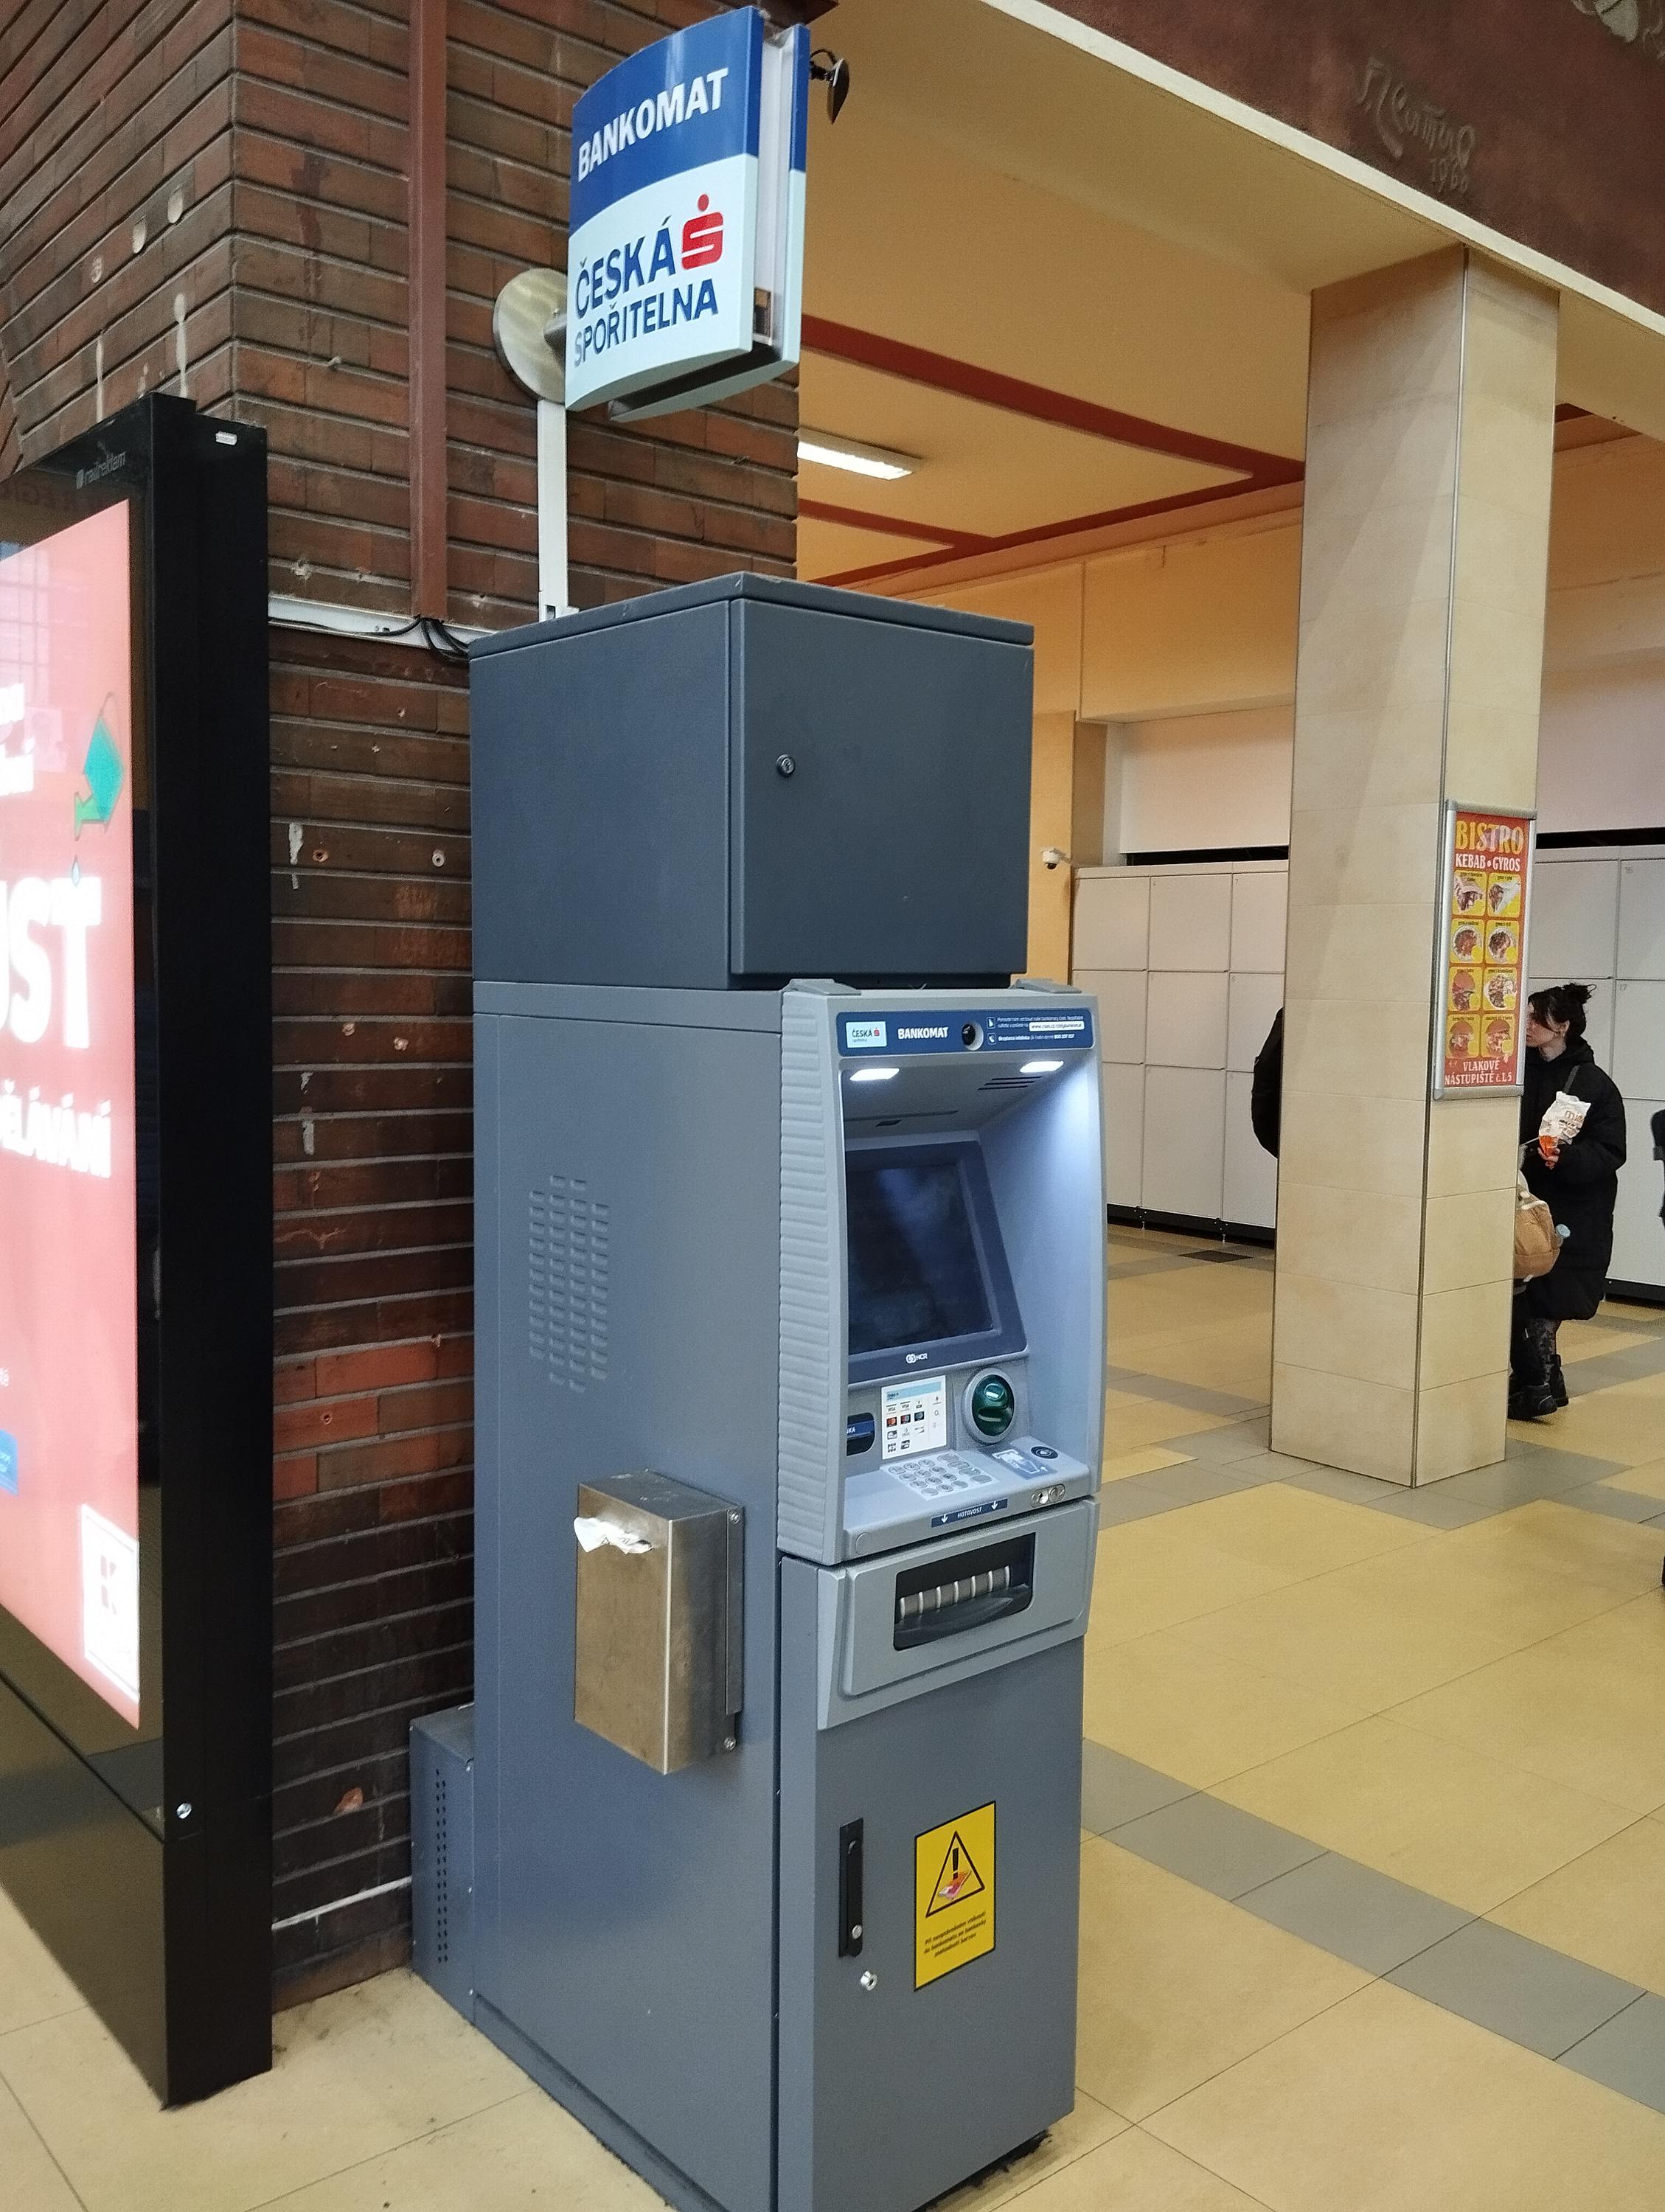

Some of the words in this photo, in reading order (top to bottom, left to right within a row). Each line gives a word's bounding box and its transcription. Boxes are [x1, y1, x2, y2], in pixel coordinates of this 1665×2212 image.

[578, 68, 729, 182] BANKOMAT
[575, 215, 676, 319] ČESKÁ
[573, 278, 719, 367] SPOŘITELNA
[1456, 820, 1524, 855] BISTRO
[1456, 853, 1487, 869] KEBAB
[1492, 856, 1521, 872] GYROS
[852, 1029, 872, 1038] ČESKÁ
[897, 1027, 948, 1040] BANKOMAT
[1463, 1057, 1501, 1071] VLAKOVÉ
[1445, 1071, 1495, 1085] NÁSTUPIŠTĚ
[0, 1079, 111, 1180] ĚLÁVÁNÍ
[916, 1353, 928, 1361] NCR
